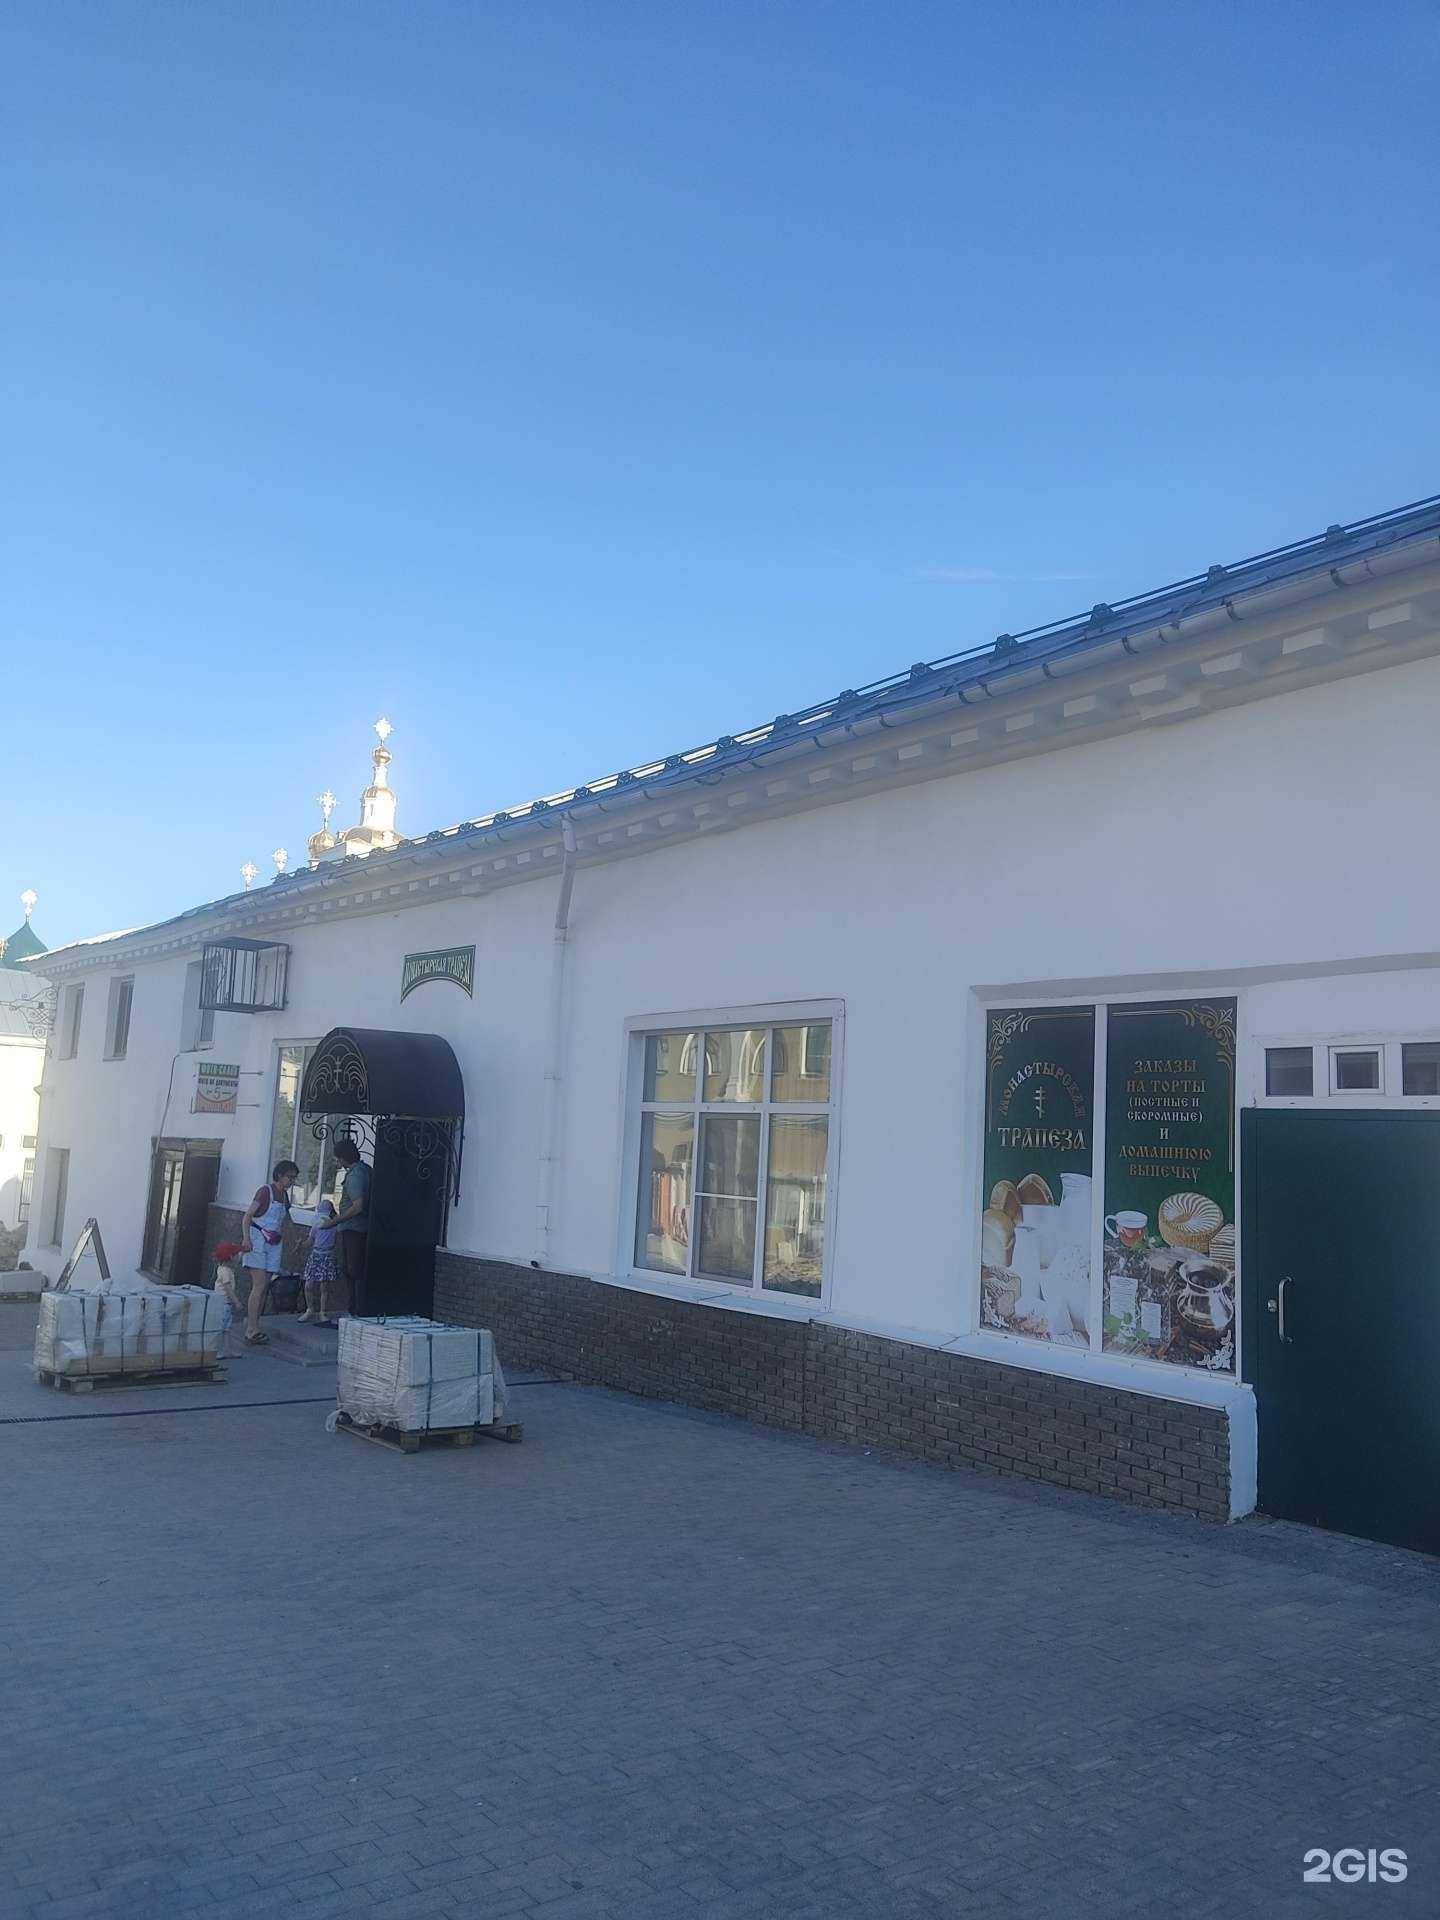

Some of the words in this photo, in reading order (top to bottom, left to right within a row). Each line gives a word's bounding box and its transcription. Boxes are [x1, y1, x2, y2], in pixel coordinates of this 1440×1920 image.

[1134, 1059, 1199, 1073] ЗАКАЗЫ
[1126, 1080, 1146, 1093] НА
[1151, 1080, 1207, 1093] ТОРТЫ
[1192, 1097, 1200, 1107] И
[998, 1127, 1088, 1152] ТРАПЕЗА
[1159, 1127, 1169, 1140] И
[1119, 1145, 1212, 1161] ДОМАШНЮЮ
[1129, 1163, 1200, 1183] ВЫПЕЧКУ
